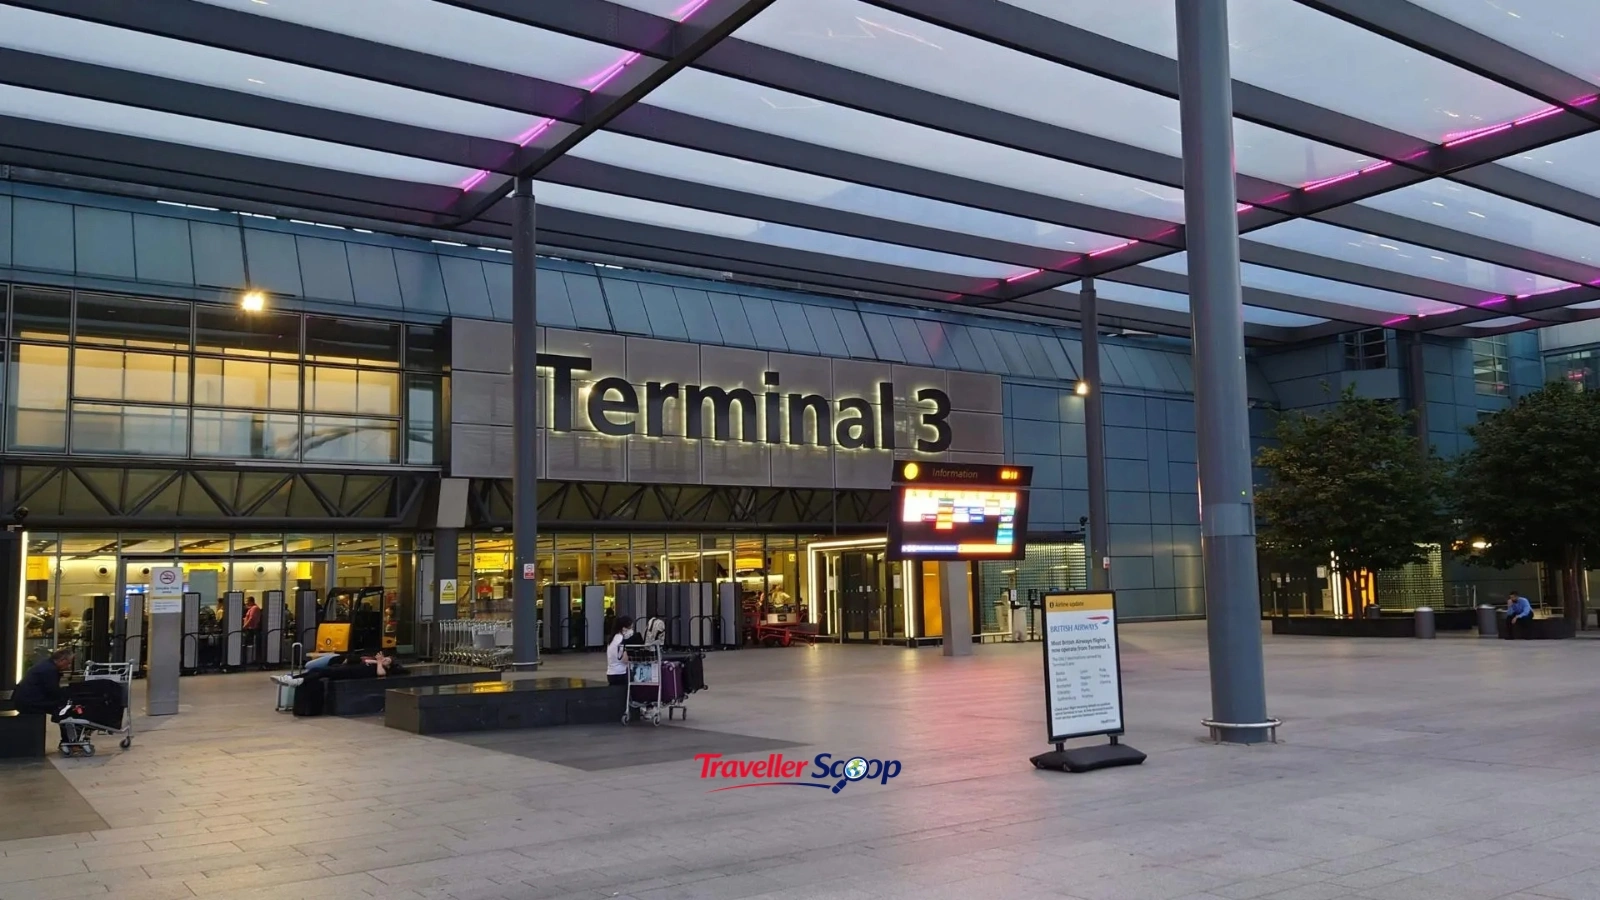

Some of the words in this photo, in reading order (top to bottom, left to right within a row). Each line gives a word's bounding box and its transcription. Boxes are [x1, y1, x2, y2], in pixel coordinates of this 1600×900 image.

[536, 353, 894, 449] Terminal
[916, 388, 952, 453] 3
[932, 468, 978, 478] Information
[1050, 624, 1073, 632] BRITISH
[1074, 623, 1099, 631] AIRWAYS
